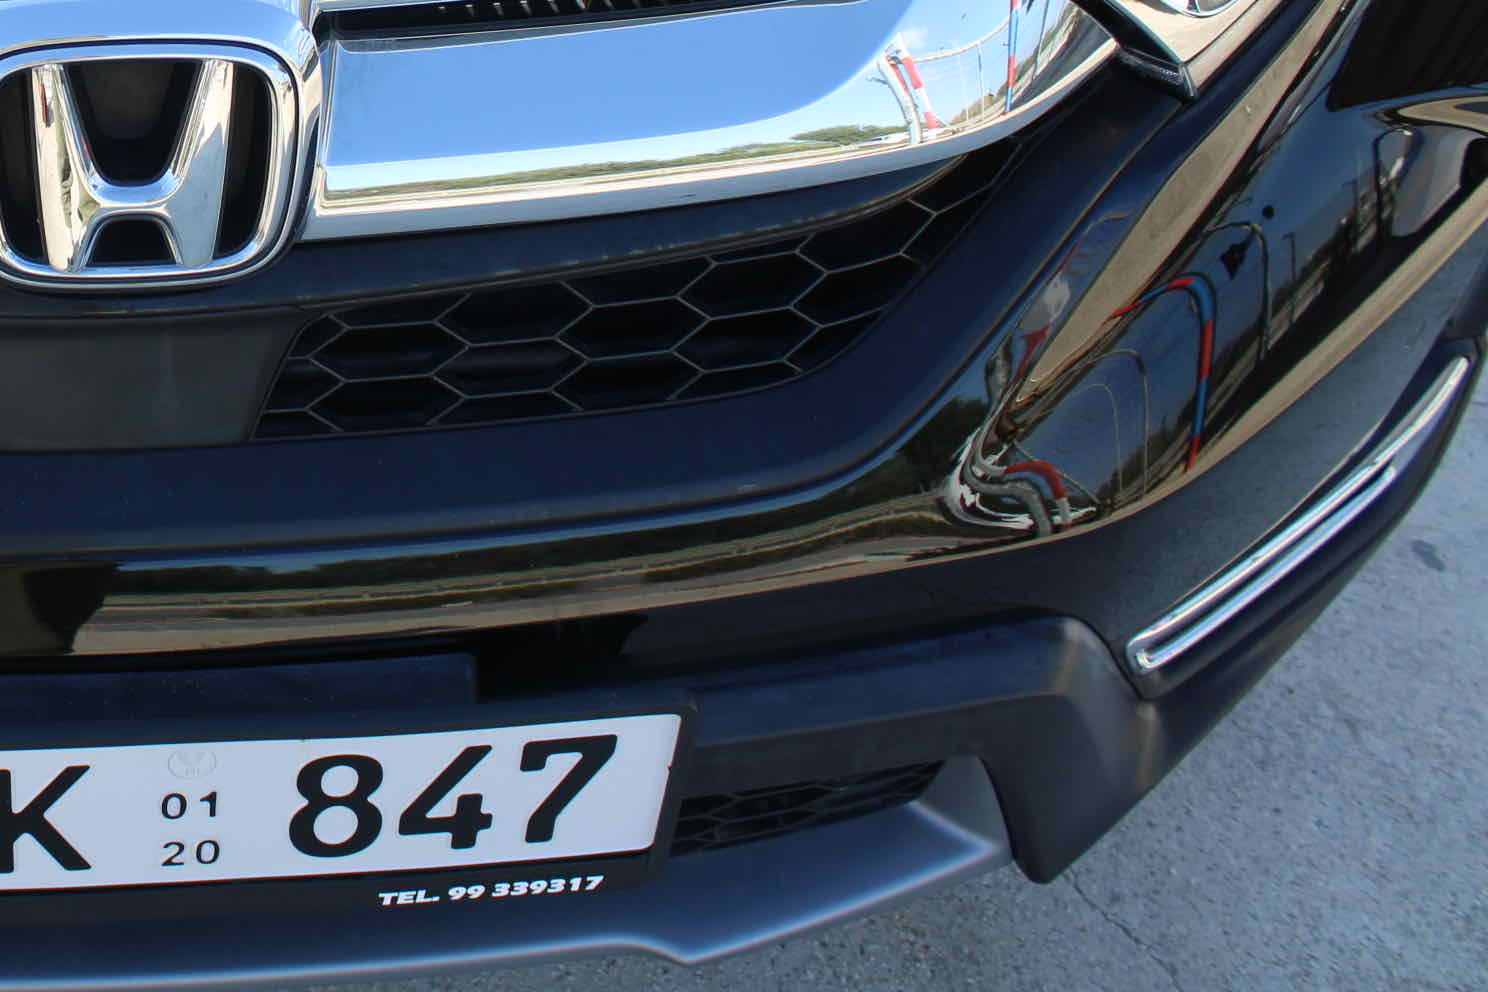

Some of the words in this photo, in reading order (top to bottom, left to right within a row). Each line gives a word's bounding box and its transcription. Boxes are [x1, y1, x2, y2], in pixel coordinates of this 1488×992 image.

[161, 791, 218, 820] 01
[288, 734, 618, 858] 847
[161, 839, 220, 867] 20
[378, 889, 440, 906] TEL.
[447, 884, 486, 901] 99
[491, 875, 604, 898] 339317
